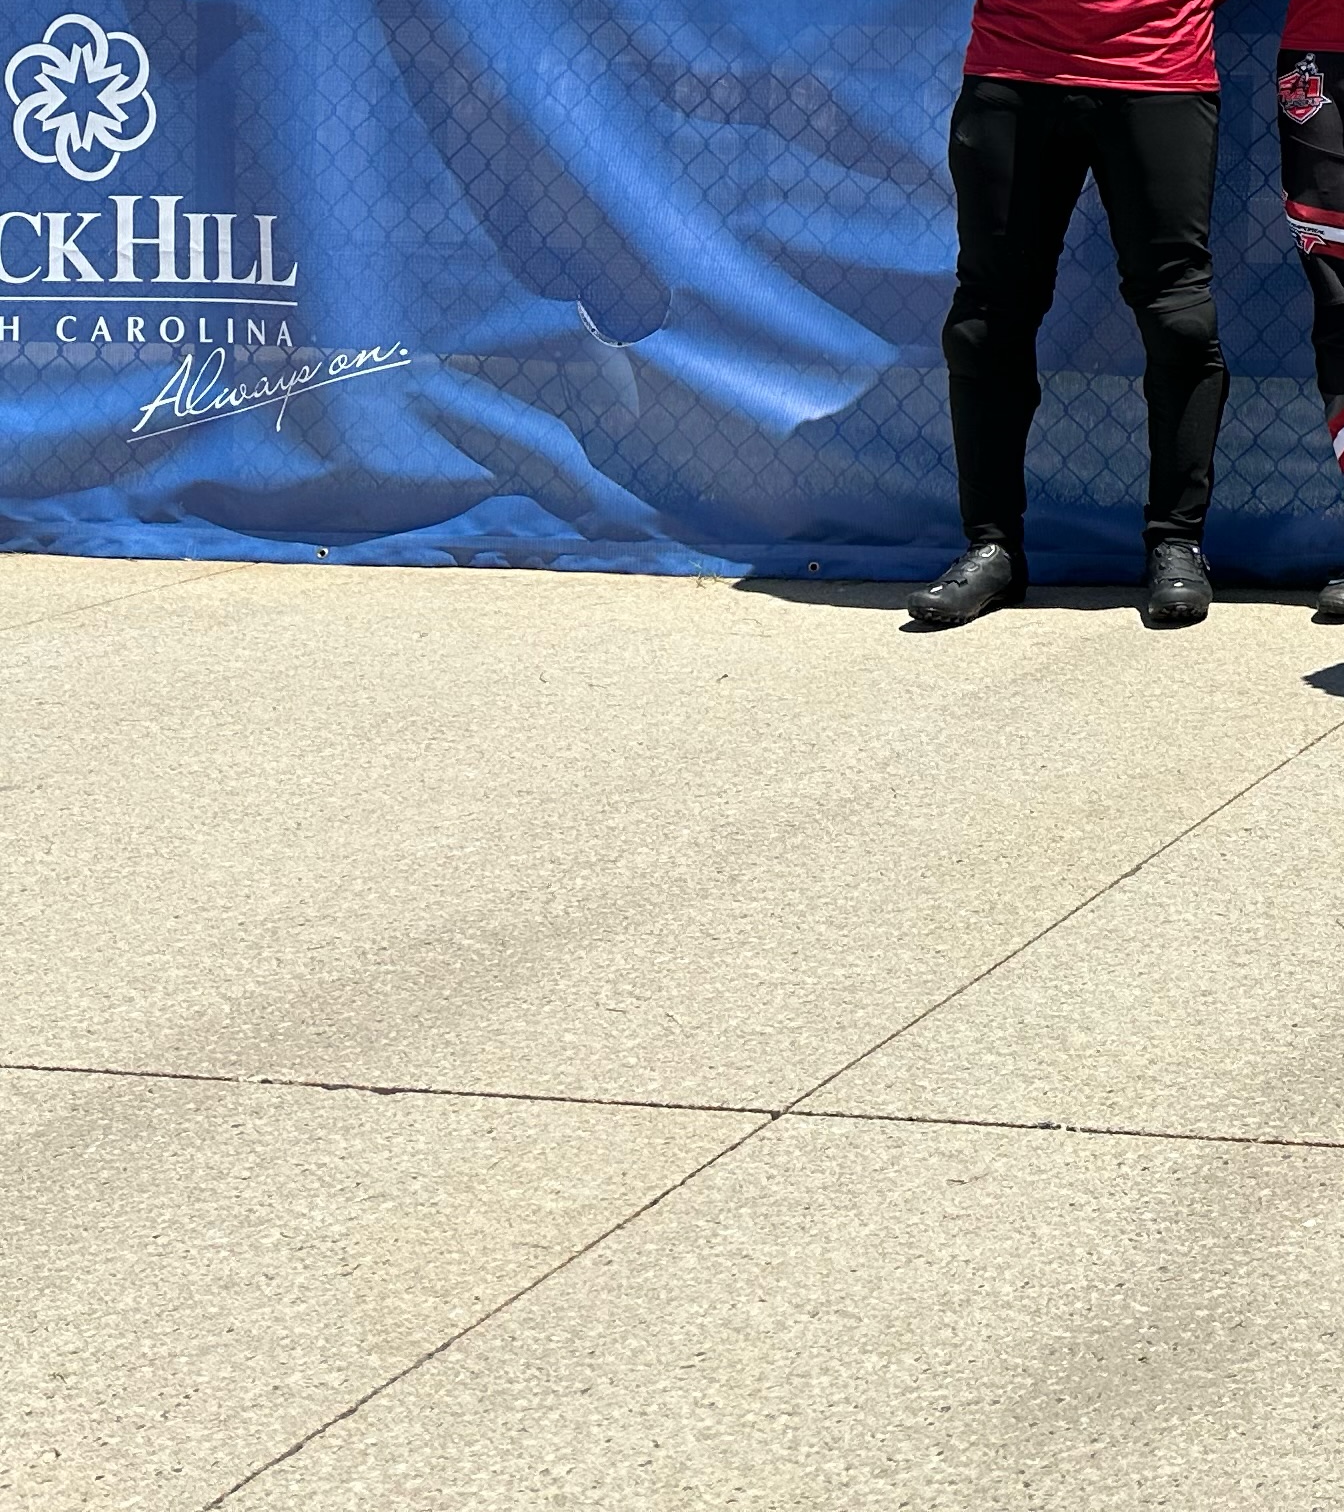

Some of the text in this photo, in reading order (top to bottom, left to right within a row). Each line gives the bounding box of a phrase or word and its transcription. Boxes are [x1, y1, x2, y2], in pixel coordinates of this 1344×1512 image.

[108, 195, 298, 287] HILL
[56, 315, 293, 347] CAROLINA
[130, 347, 323, 432] Always
